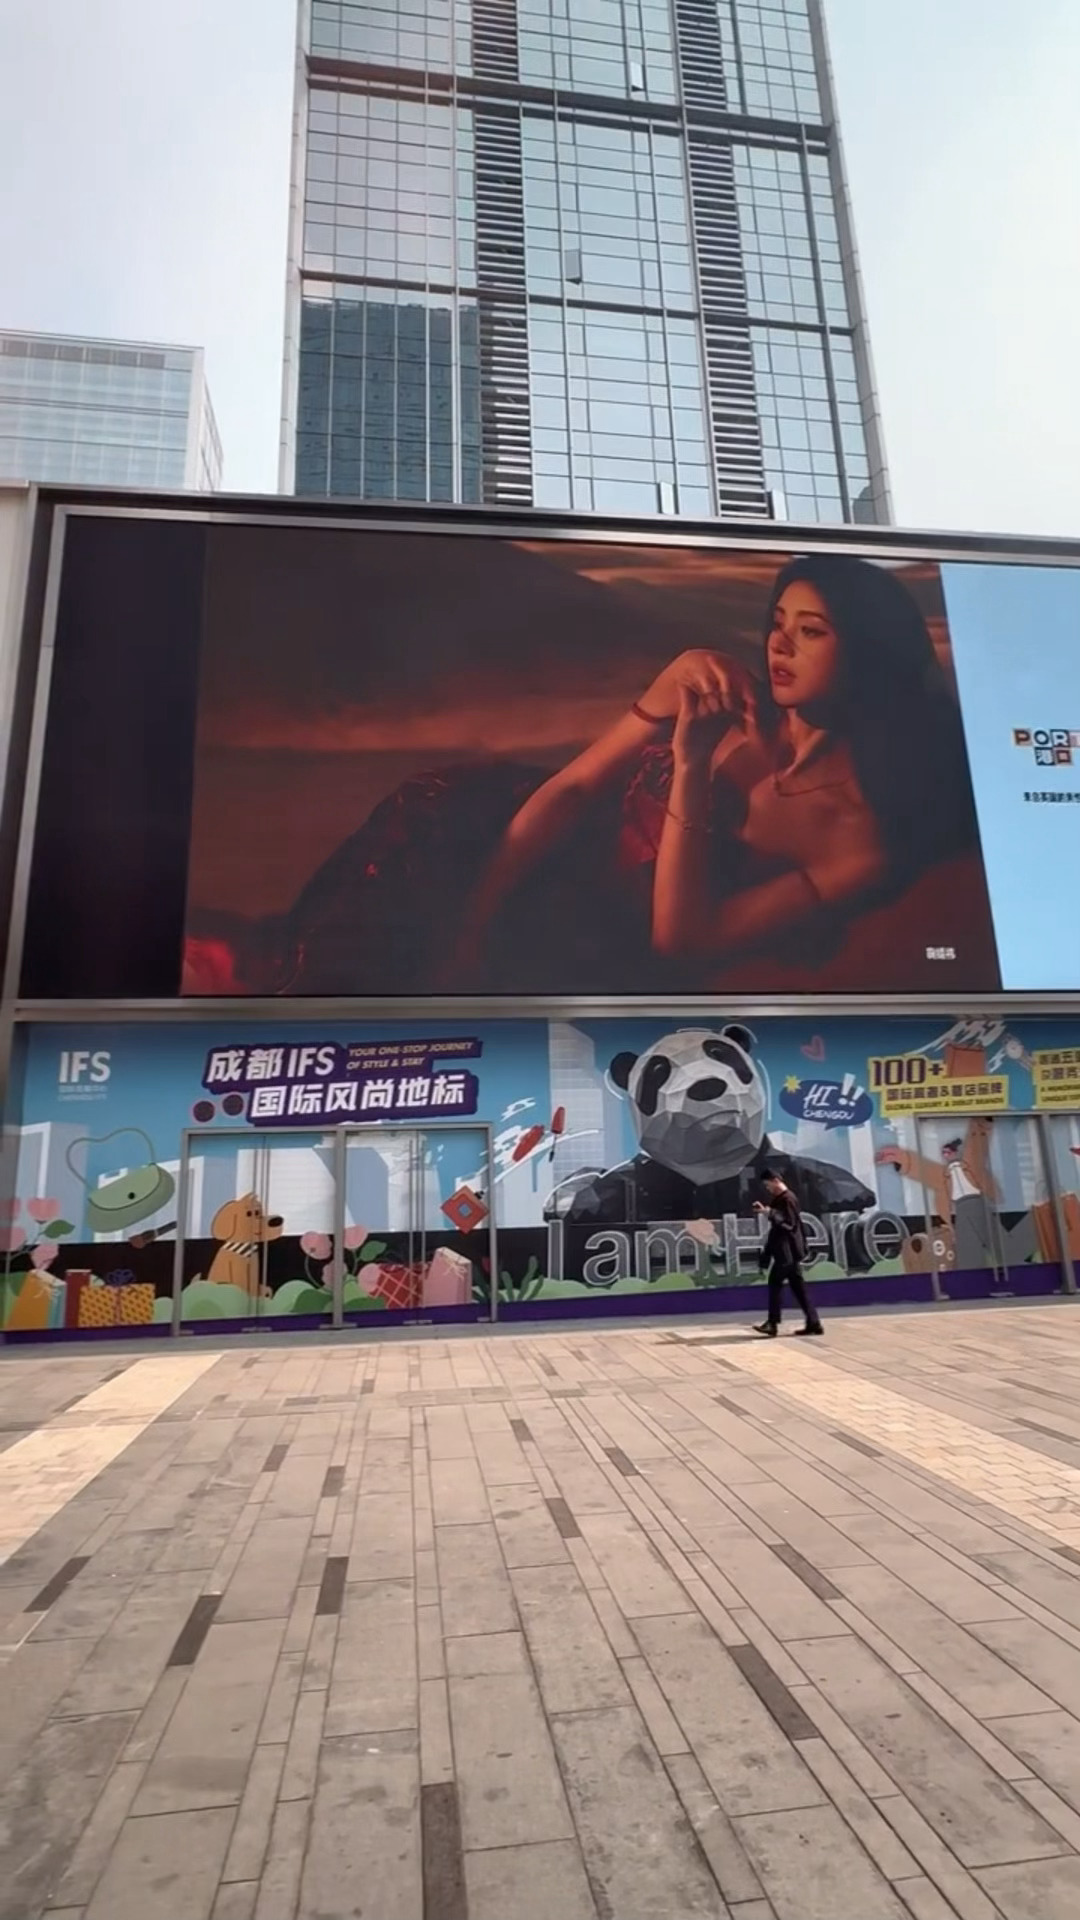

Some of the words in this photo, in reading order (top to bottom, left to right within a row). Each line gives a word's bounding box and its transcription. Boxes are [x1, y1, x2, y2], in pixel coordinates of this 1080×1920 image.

[206, 1047, 335, 1083] 成都IFS
[346, 1061, 361, 1070] OF
[362, 1059, 389, 1069] STYLE
[401, 1057, 426, 1066] STAY
[349, 1047, 377, 1057] YOUR
[429, 1042, 474, 1053] JOURNEY
[60, 1051, 111, 1083] IFS
[873, 1058, 943, 1087] 100+
[251, 1074, 466, 1118] 国际风尚地标
[583, 1228, 706, 1286] am
